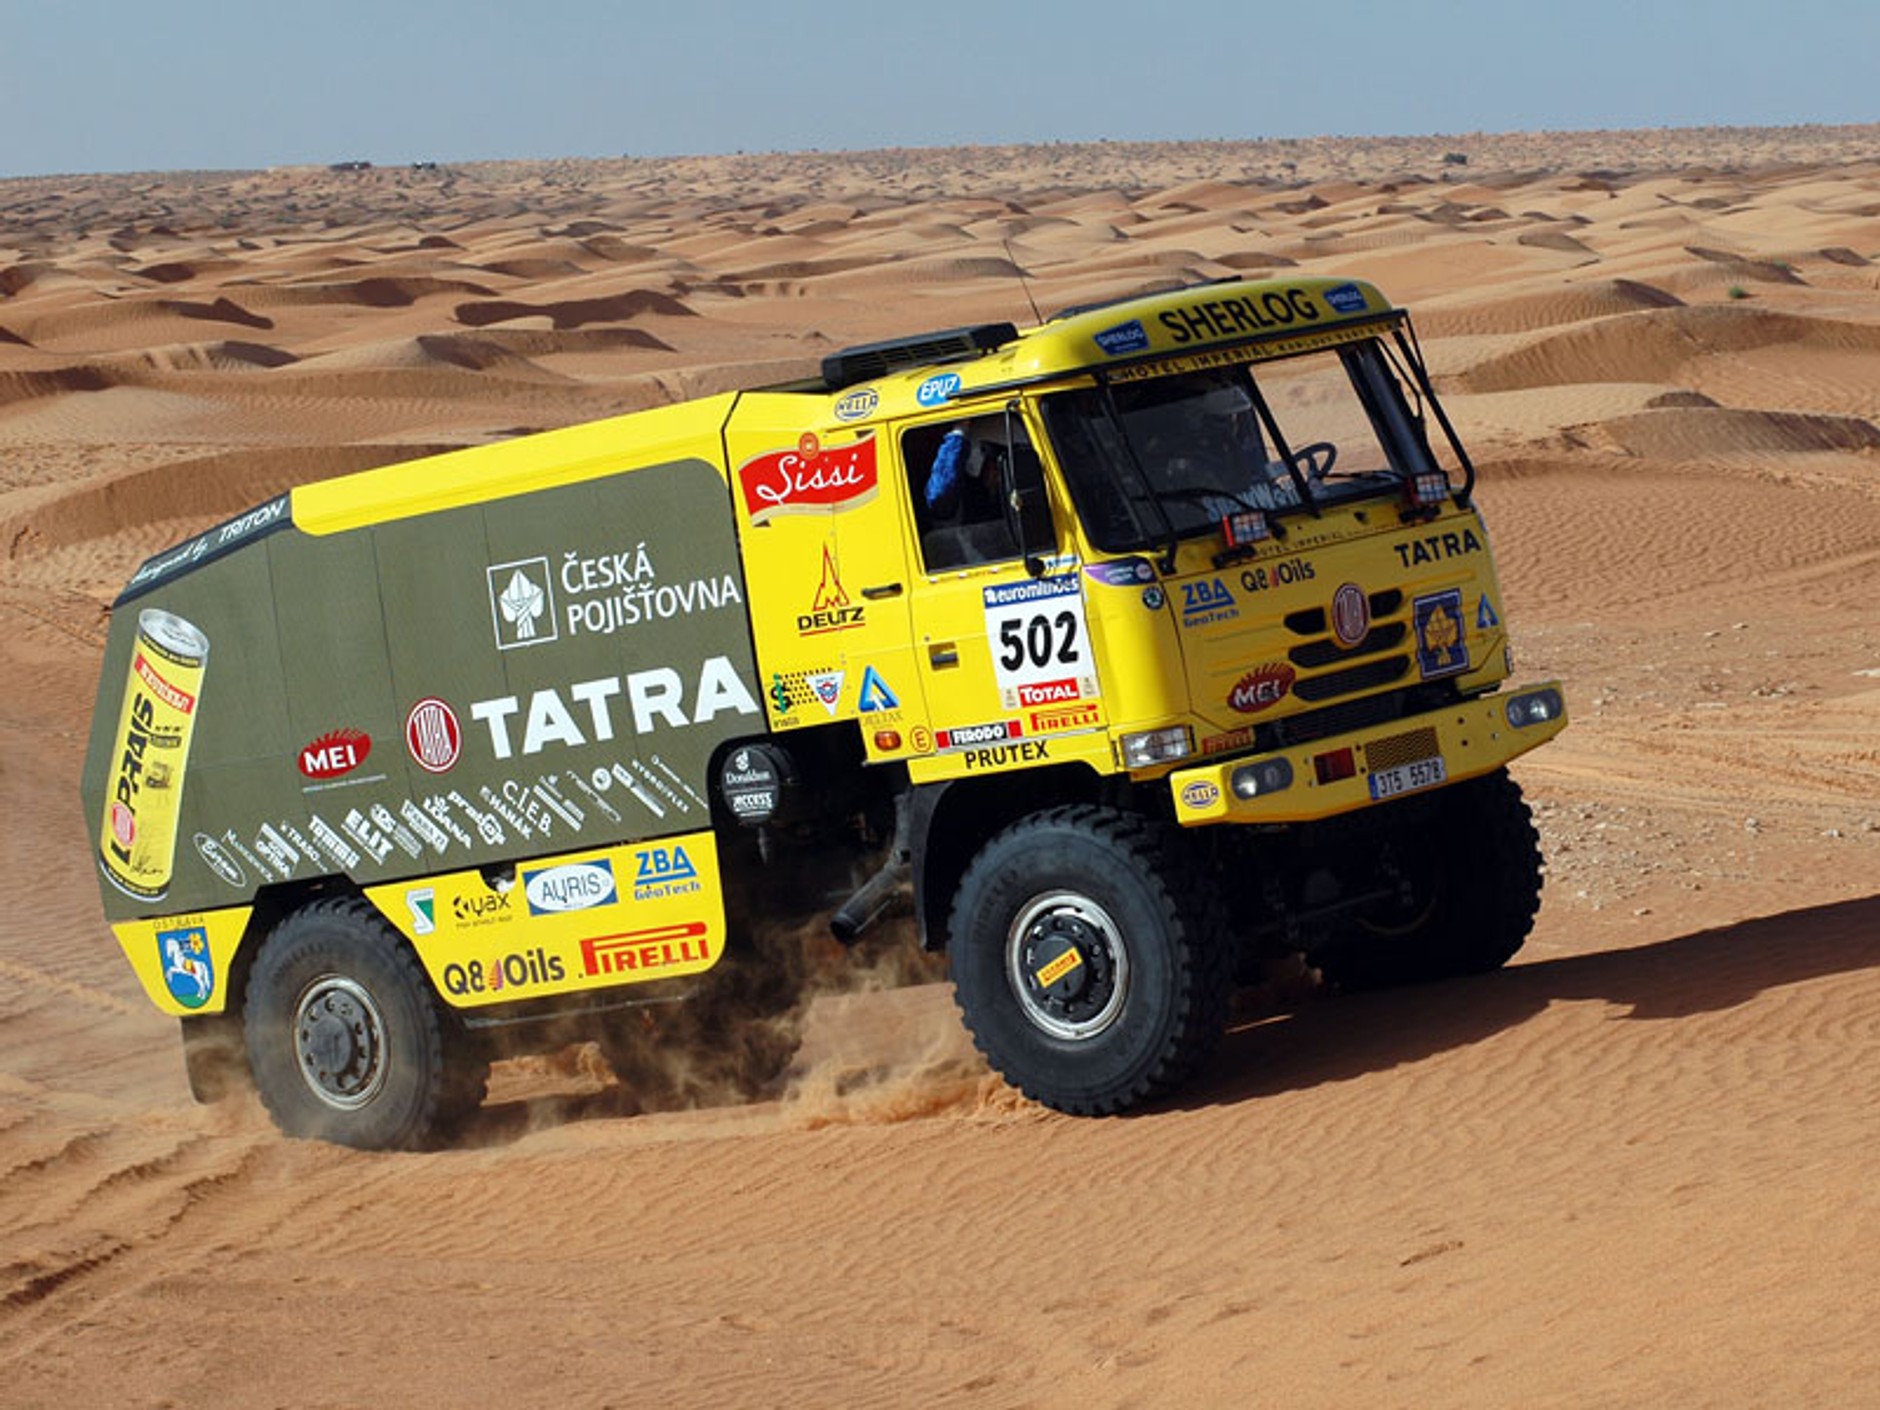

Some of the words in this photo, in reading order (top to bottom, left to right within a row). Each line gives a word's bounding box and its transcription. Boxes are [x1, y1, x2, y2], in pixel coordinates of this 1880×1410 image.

[1158, 289, 1320, 343] SHERLOG
[1123, 359, 1185, 381] HOTEL
[755, 453, 864, 505] Sissi
[1393, 528, 1482, 568] TATRA
[561, 541, 655, 594] ČESKÁ
[1277, 558, 1316, 585] Oils
[566, 574, 742, 635] POJIŠŤOVNA
[796, 606, 865, 630] DEUTZ
[1000, 611, 1080, 672] 502
[469, 655, 761, 759] TATRA
[1020, 684, 1079, 704] TOTAL
[1030, 703, 1100, 732] PIRELLI
[303, 744, 358, 774] MEI
[964, 740, 1050, 769] PRUTEX
[1376, 771, 1403, 796] 3T5
[344, 807, 394, 858] ELIT
[634, 846, 697, 879] ZBA
[541, 874, 602, 904] AURIS
[634, 880, 701, 901] GeoTech
[579, 921, 710, 977] PIRELLI
[442, 959, 485, 996] Q8
[502, 948, 566, 986] Oils
